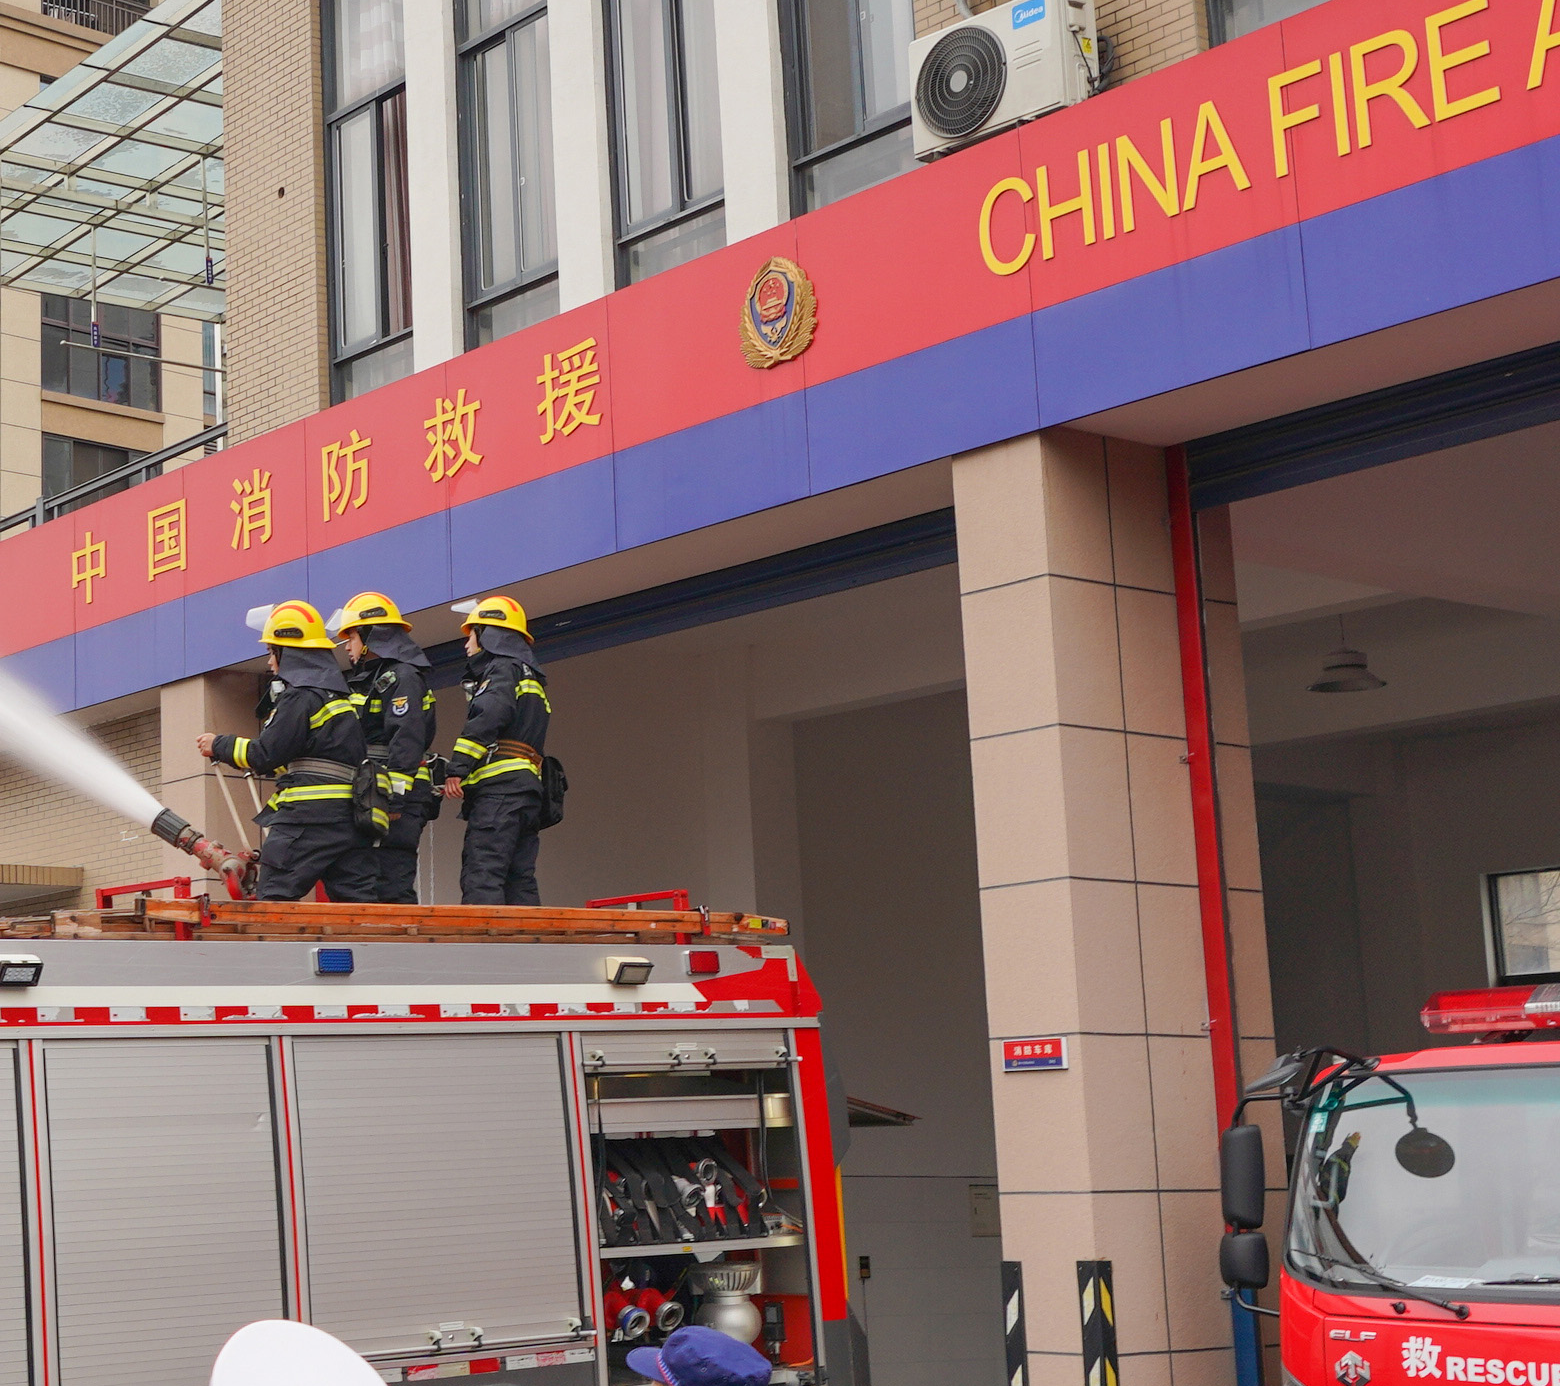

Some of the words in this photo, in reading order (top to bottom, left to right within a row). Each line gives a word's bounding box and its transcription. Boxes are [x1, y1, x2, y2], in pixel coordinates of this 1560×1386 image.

[1014, 5, 1044, 24] Midea
[978, 100, 1251, 276] CHINA
[71, 337, 603, 604] 中国消防救援
[1329, 1329, 1377, 1341] ELF
[1401, 1335, 1442, 1379] 救
